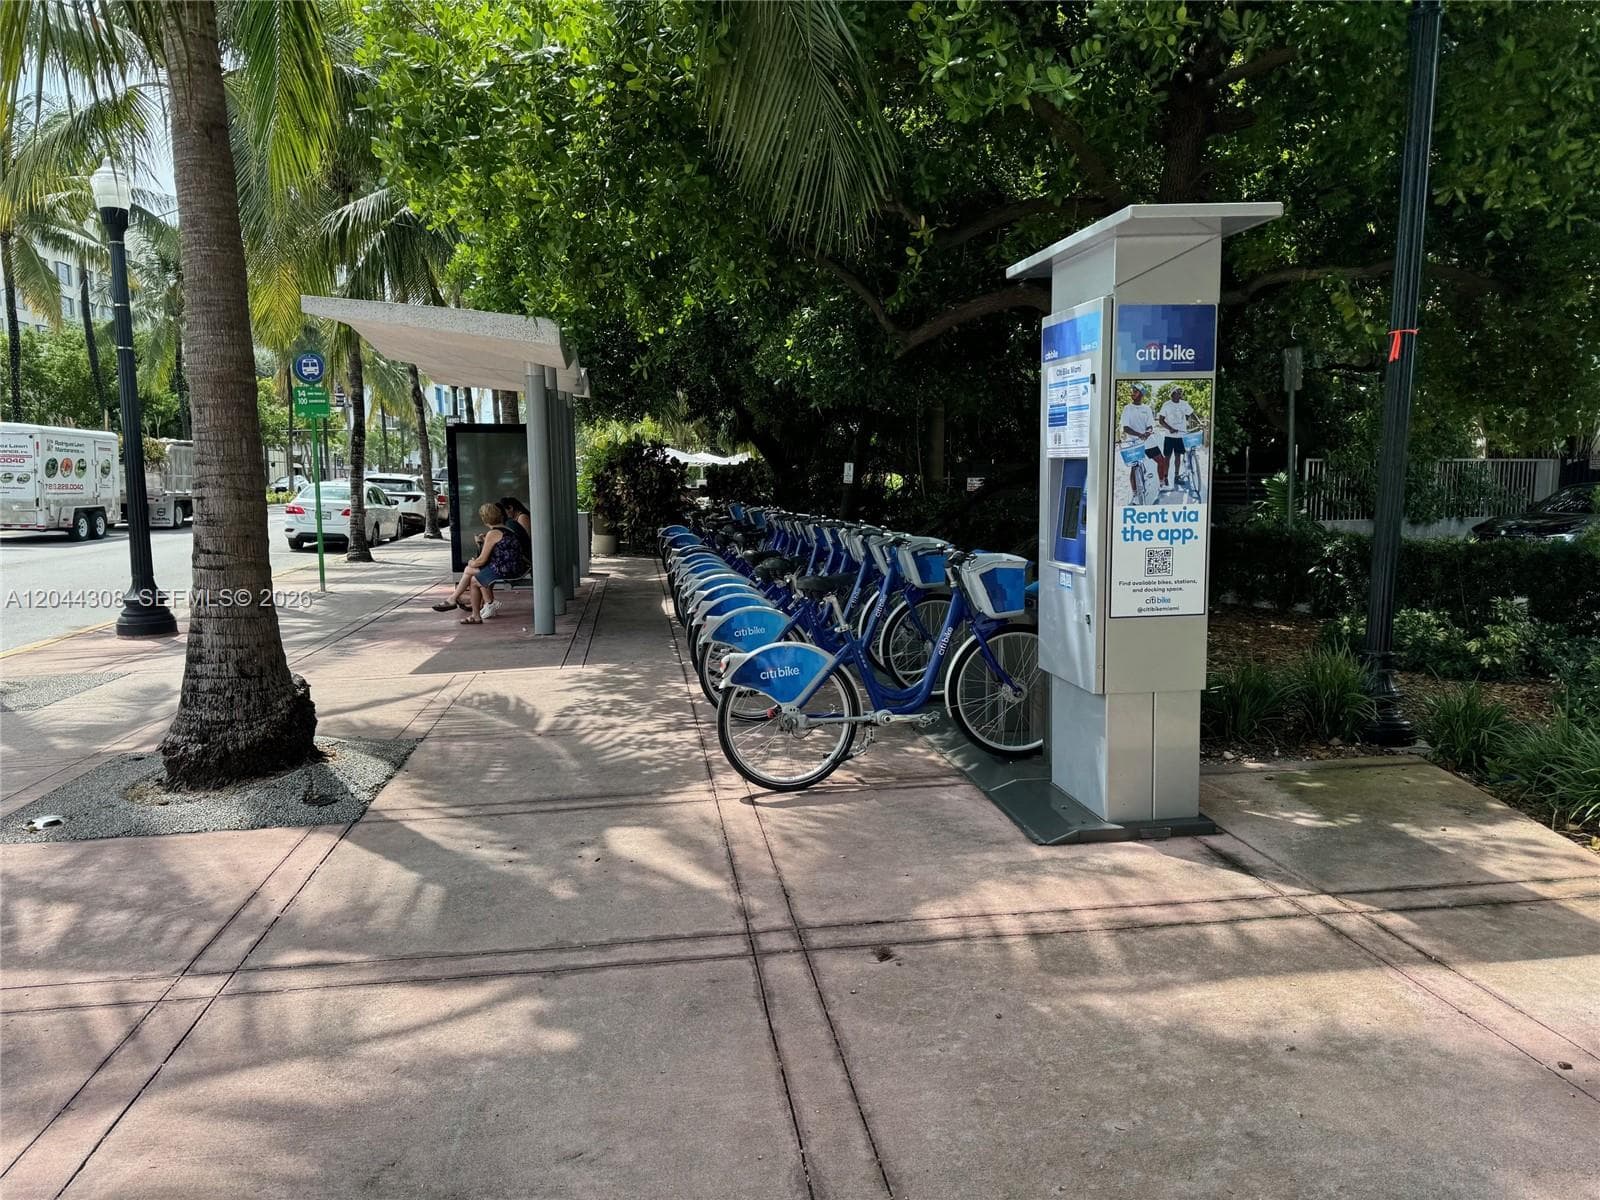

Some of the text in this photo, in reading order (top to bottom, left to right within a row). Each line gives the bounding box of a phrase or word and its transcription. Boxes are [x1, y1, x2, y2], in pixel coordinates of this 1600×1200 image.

[1136, 344, 1195, 361] citi bike
[1123, 506, 1199, 524] Rent via
[1121, 526, 1198, 545] the app.
[734, 624, 766, 637] citi bike
[760, 665, 800, 680] citi bike
